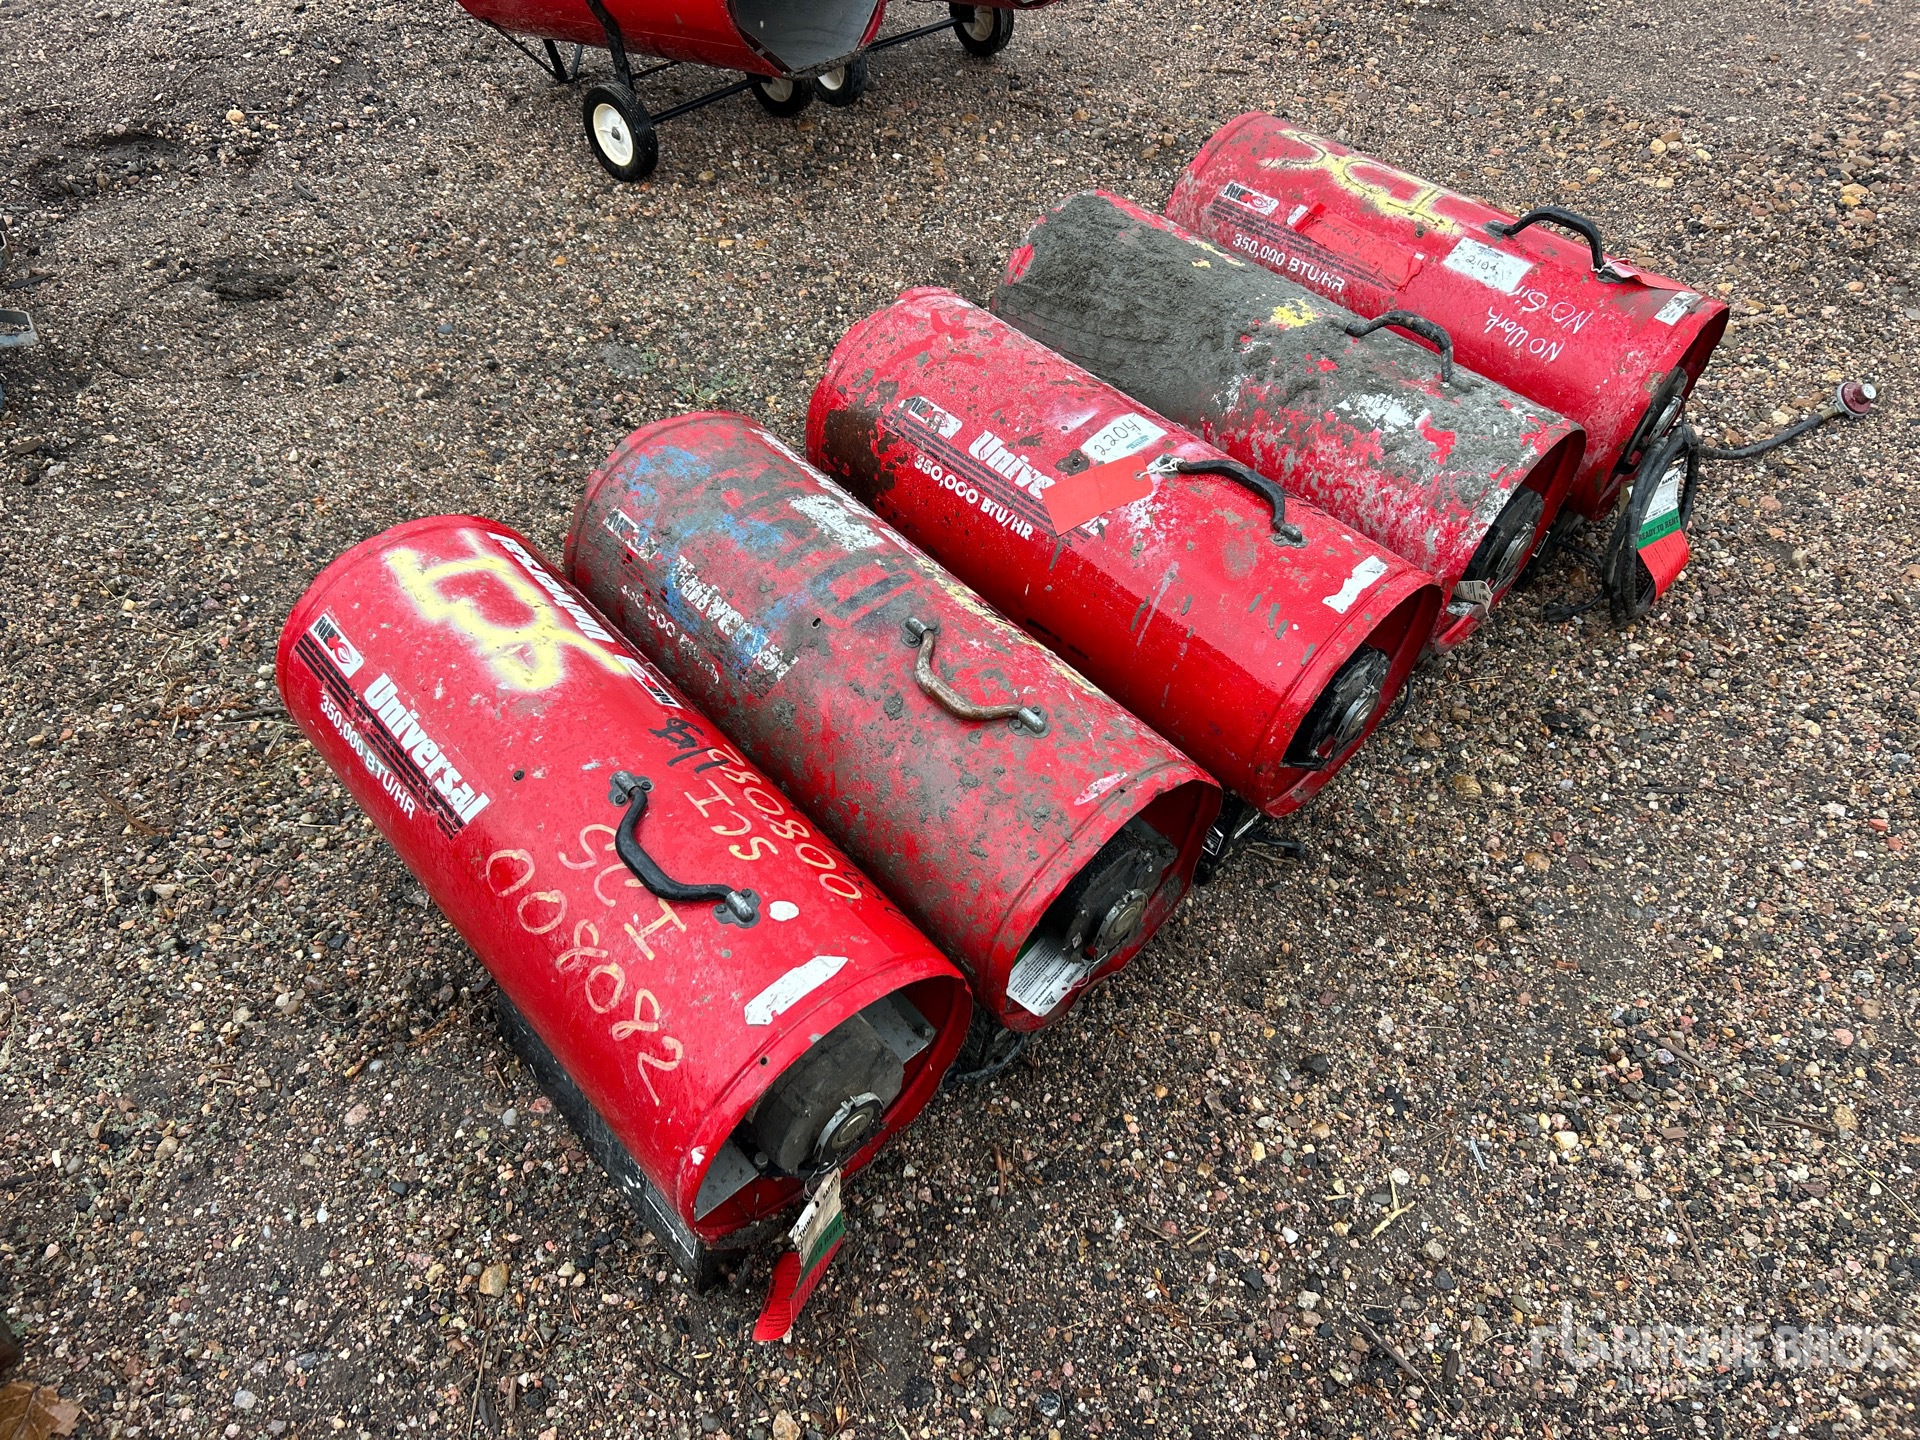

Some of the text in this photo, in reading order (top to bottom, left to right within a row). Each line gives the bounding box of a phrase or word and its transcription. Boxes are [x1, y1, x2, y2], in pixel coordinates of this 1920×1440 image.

[1232, 233, 1346, 294] 350,000 BTU/HR
[1484, 306, 1565, 362] NO Work
[1551, 301, 1595, 334] NO
[1094, 418, 1142, 456] 2204
[913, 454, 979, 504] 350,000
[979, 499, 1034, 541] BTU/HR
[1656, 524, 1665, 533] TO
[1664, 515, 1680, 530] RENT
[319, 695, 417, 820] 350,000 BTU/HR
[364, 672, 491, 825] Universal
[684, 778, 778, 861] SCI
[485, 848, 685, 1108] 008082
[798, 1213, 815, 1239] THINK
